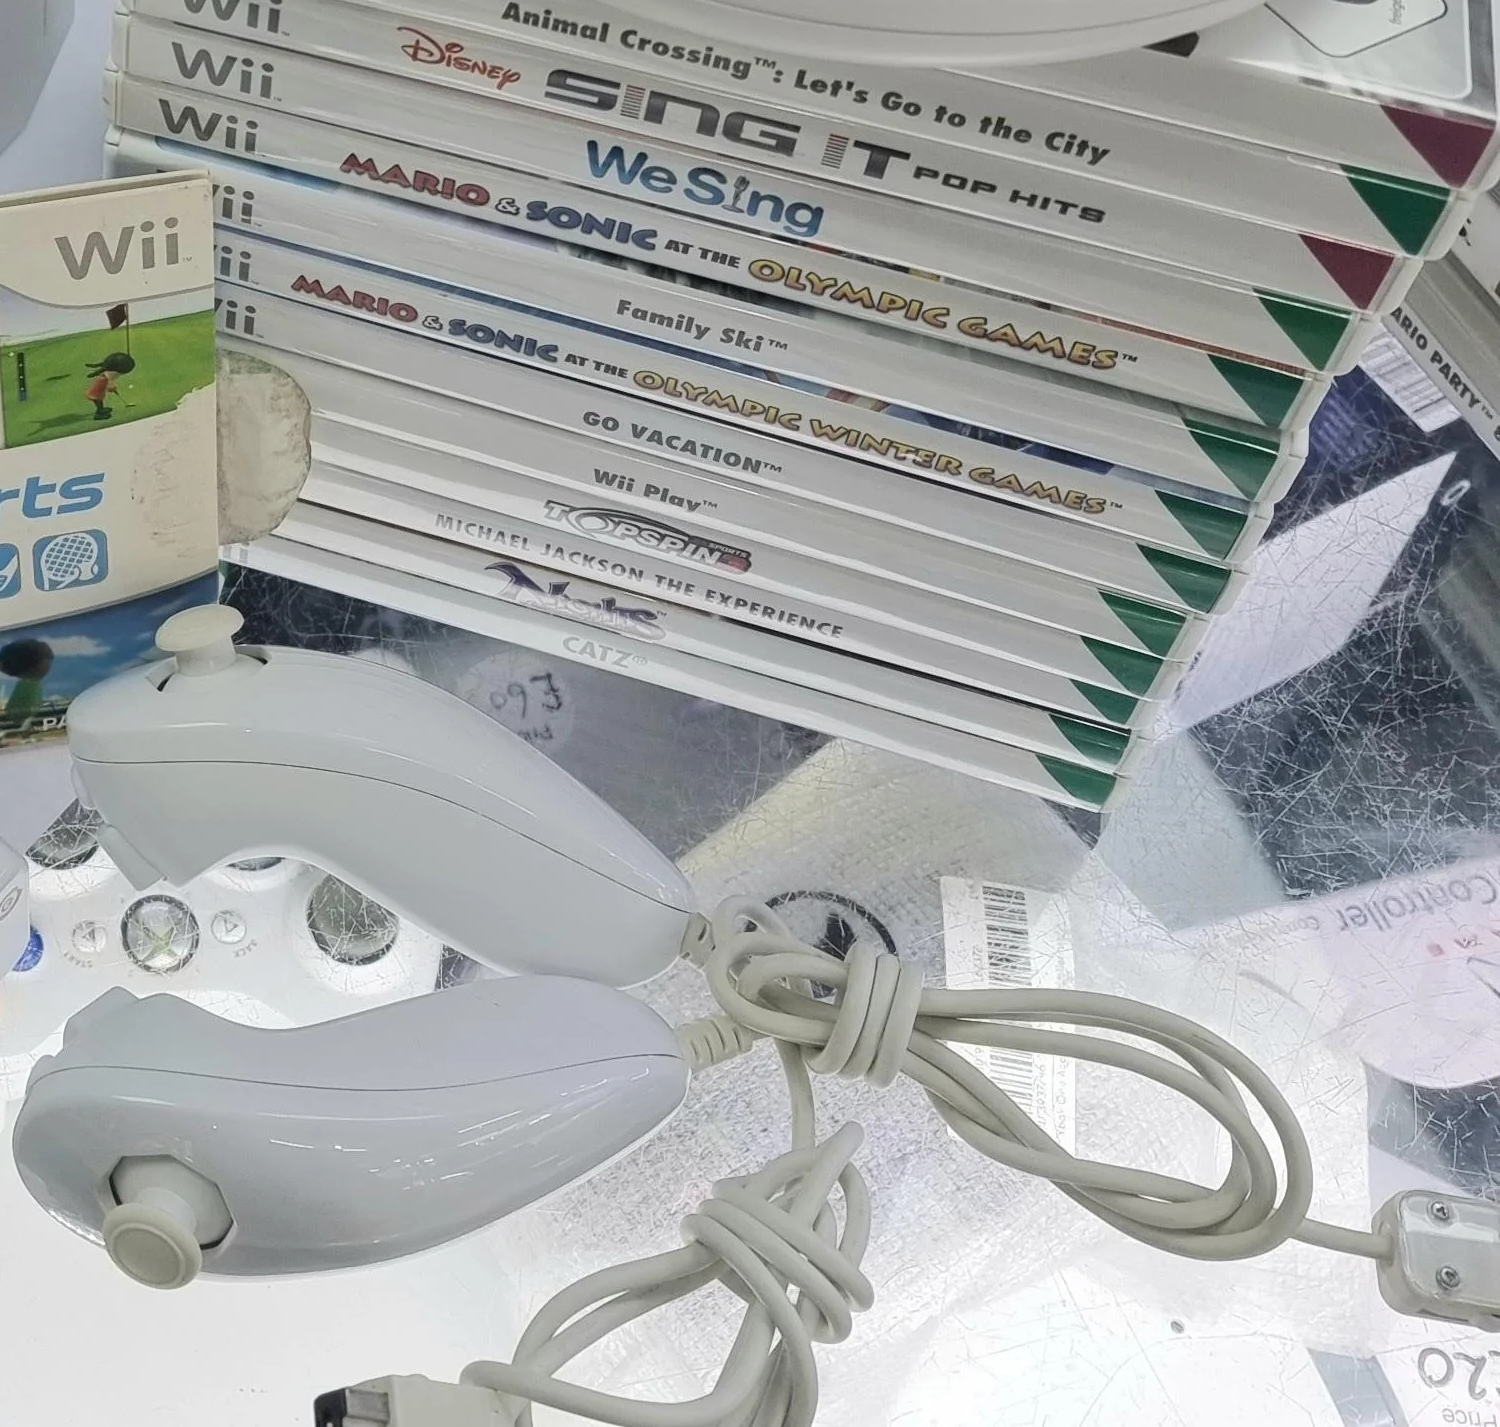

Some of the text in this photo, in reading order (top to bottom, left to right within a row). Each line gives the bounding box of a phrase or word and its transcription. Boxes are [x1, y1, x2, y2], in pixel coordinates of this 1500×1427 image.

[157, 99, 259, 152] Wii
[171, 41, 275, 99] Wii
[912, 164, 997, 196] POP
[1010, 188, 1105, 224] HITS
[501, 2, 608, 43] Animal
[793, 69, 869, 106] Let's
[881, 91, 922, 118] Go
[934, 105, 966, 129] to
[979, 116, 1033, 145] the
[1044, 132, 1111, 167] City
[213, 184, 255, 224] ii
[340, 153, 490, 206] MARIO
[526, 200, 658, 252] SONIC
[665, 239, 695, 256] AT
[700, 248, 740, 269] THE
[749, 258, 949, 329] OLYMPIC
[214, 245, 252, 281] ii
[617, 300, 710, 340] Family
[215, 297, 256, 335] ii
[291, 275, 418, 323] MARIO
[448, 319, 558, 363] SONIC
[563, 353, 589, 367] AT
[593, 361, 627, 379] THE
[633, 370, 800, 431] OLYMPIC
[810, 417, 962, 476] WINTER
[1390, 306, 1428, 351] ARIO
[582, 410, 620, 432] GO
[593, 468, 635, 491] Wii
[434, 513, 843, 639] MICHAEL JACKSON THE EXPERIENCE
